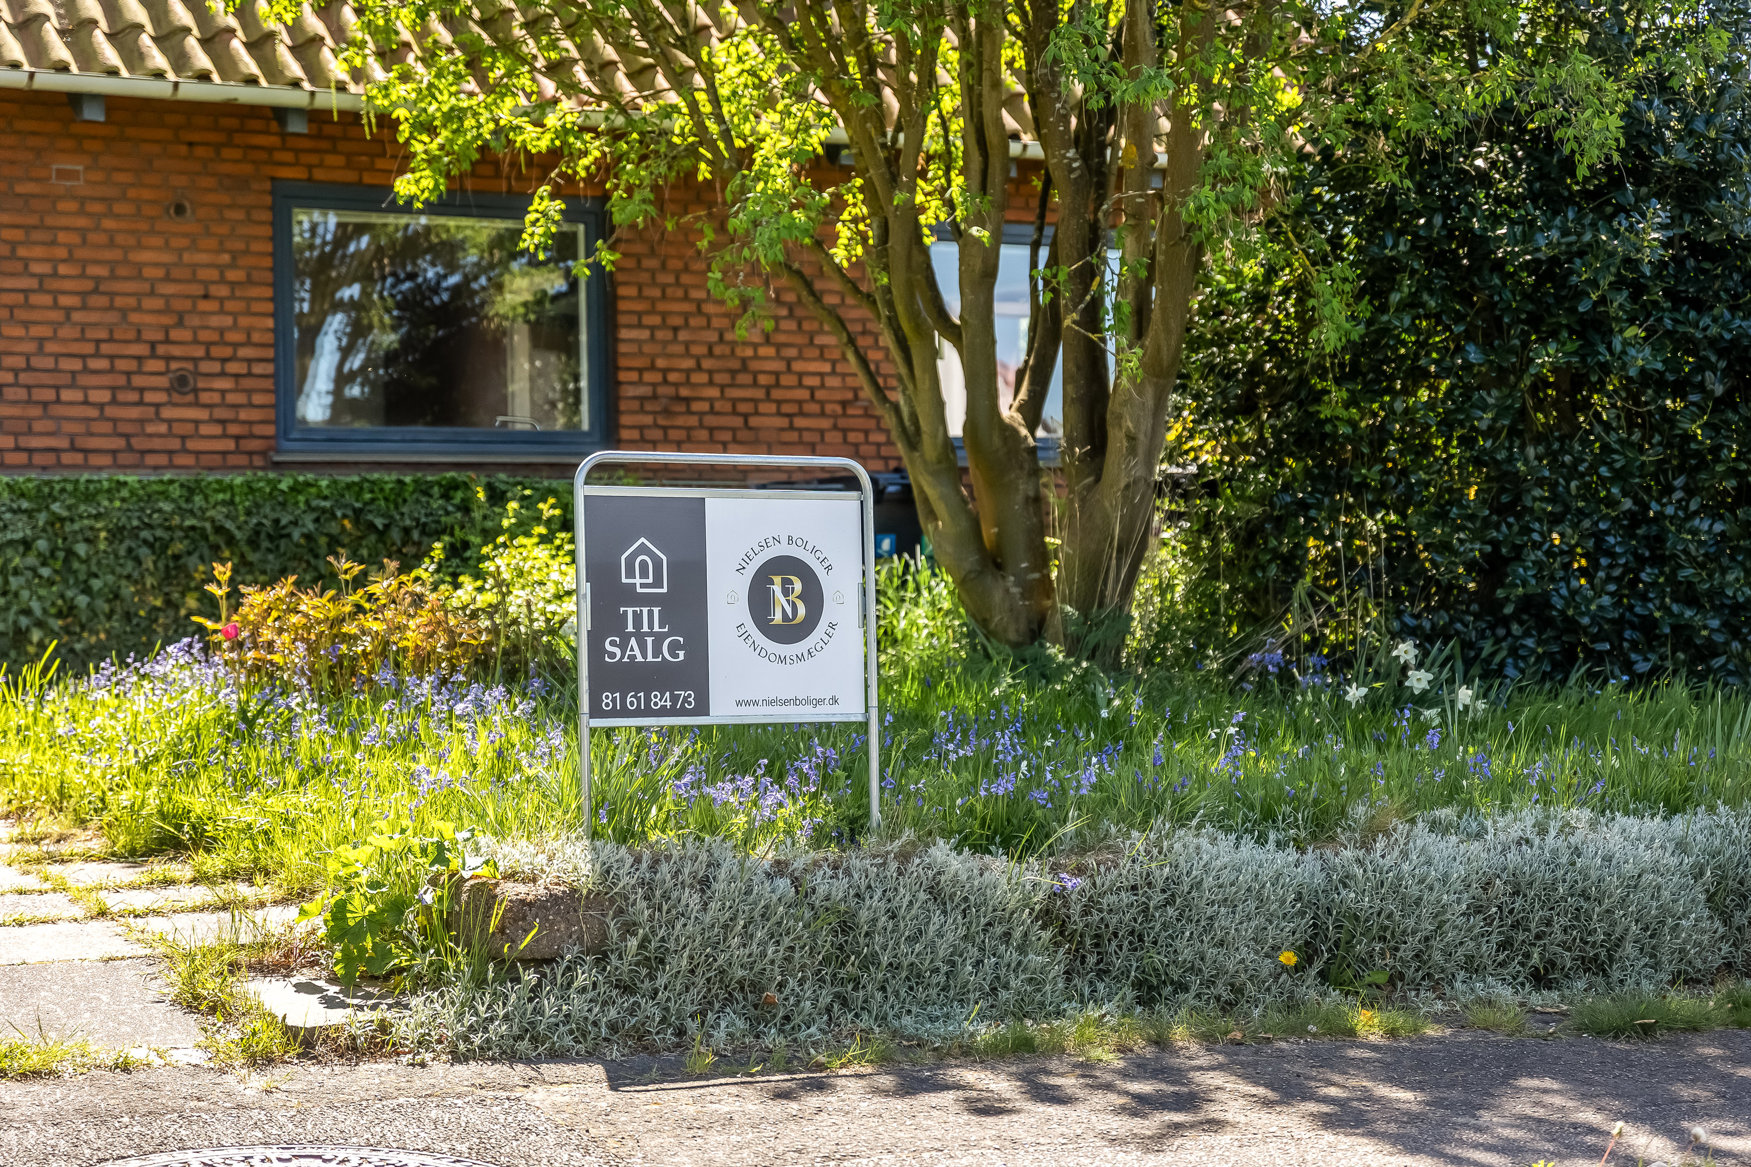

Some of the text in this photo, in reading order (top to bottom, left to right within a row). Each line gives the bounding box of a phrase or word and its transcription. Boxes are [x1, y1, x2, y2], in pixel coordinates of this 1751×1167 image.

[735, 534, 834, 577] NIELSEN BOLIGER
[619, 606, 669, 632] TIL
[604, 636, 686, 663] SALG
[735, 620, 839, 666] EJENDOMSMÆGLER
[601, 690, 696, 711] 81 61 84 73
[734, 694, 840, 709] www.nielsenboliger.dk
